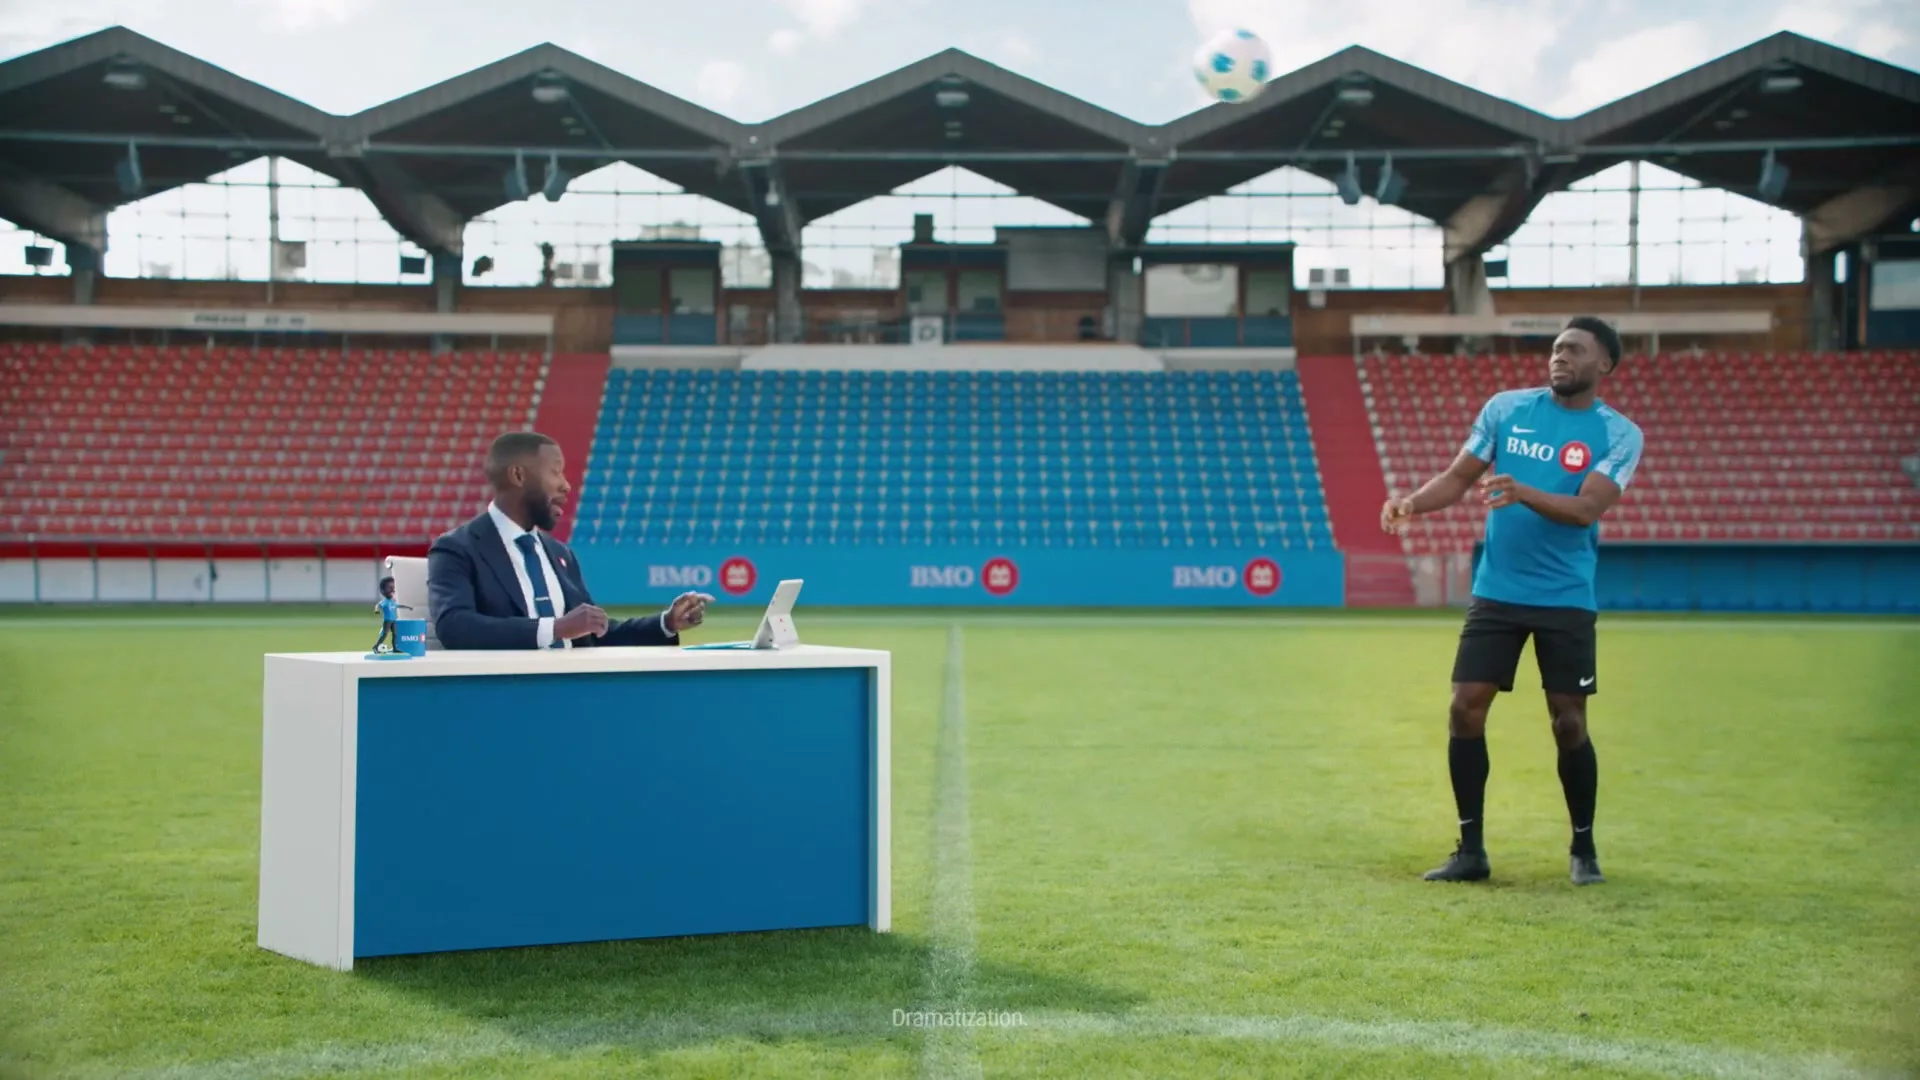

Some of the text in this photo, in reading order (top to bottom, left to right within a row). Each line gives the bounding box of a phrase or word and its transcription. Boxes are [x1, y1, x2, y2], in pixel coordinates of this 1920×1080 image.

[1506, 436, 1555, 462] BMO
[648, 564, 712, 588] BMO
[910, 564, 975, 588] BMO
[1172, 564, 1237, 588] BMO
